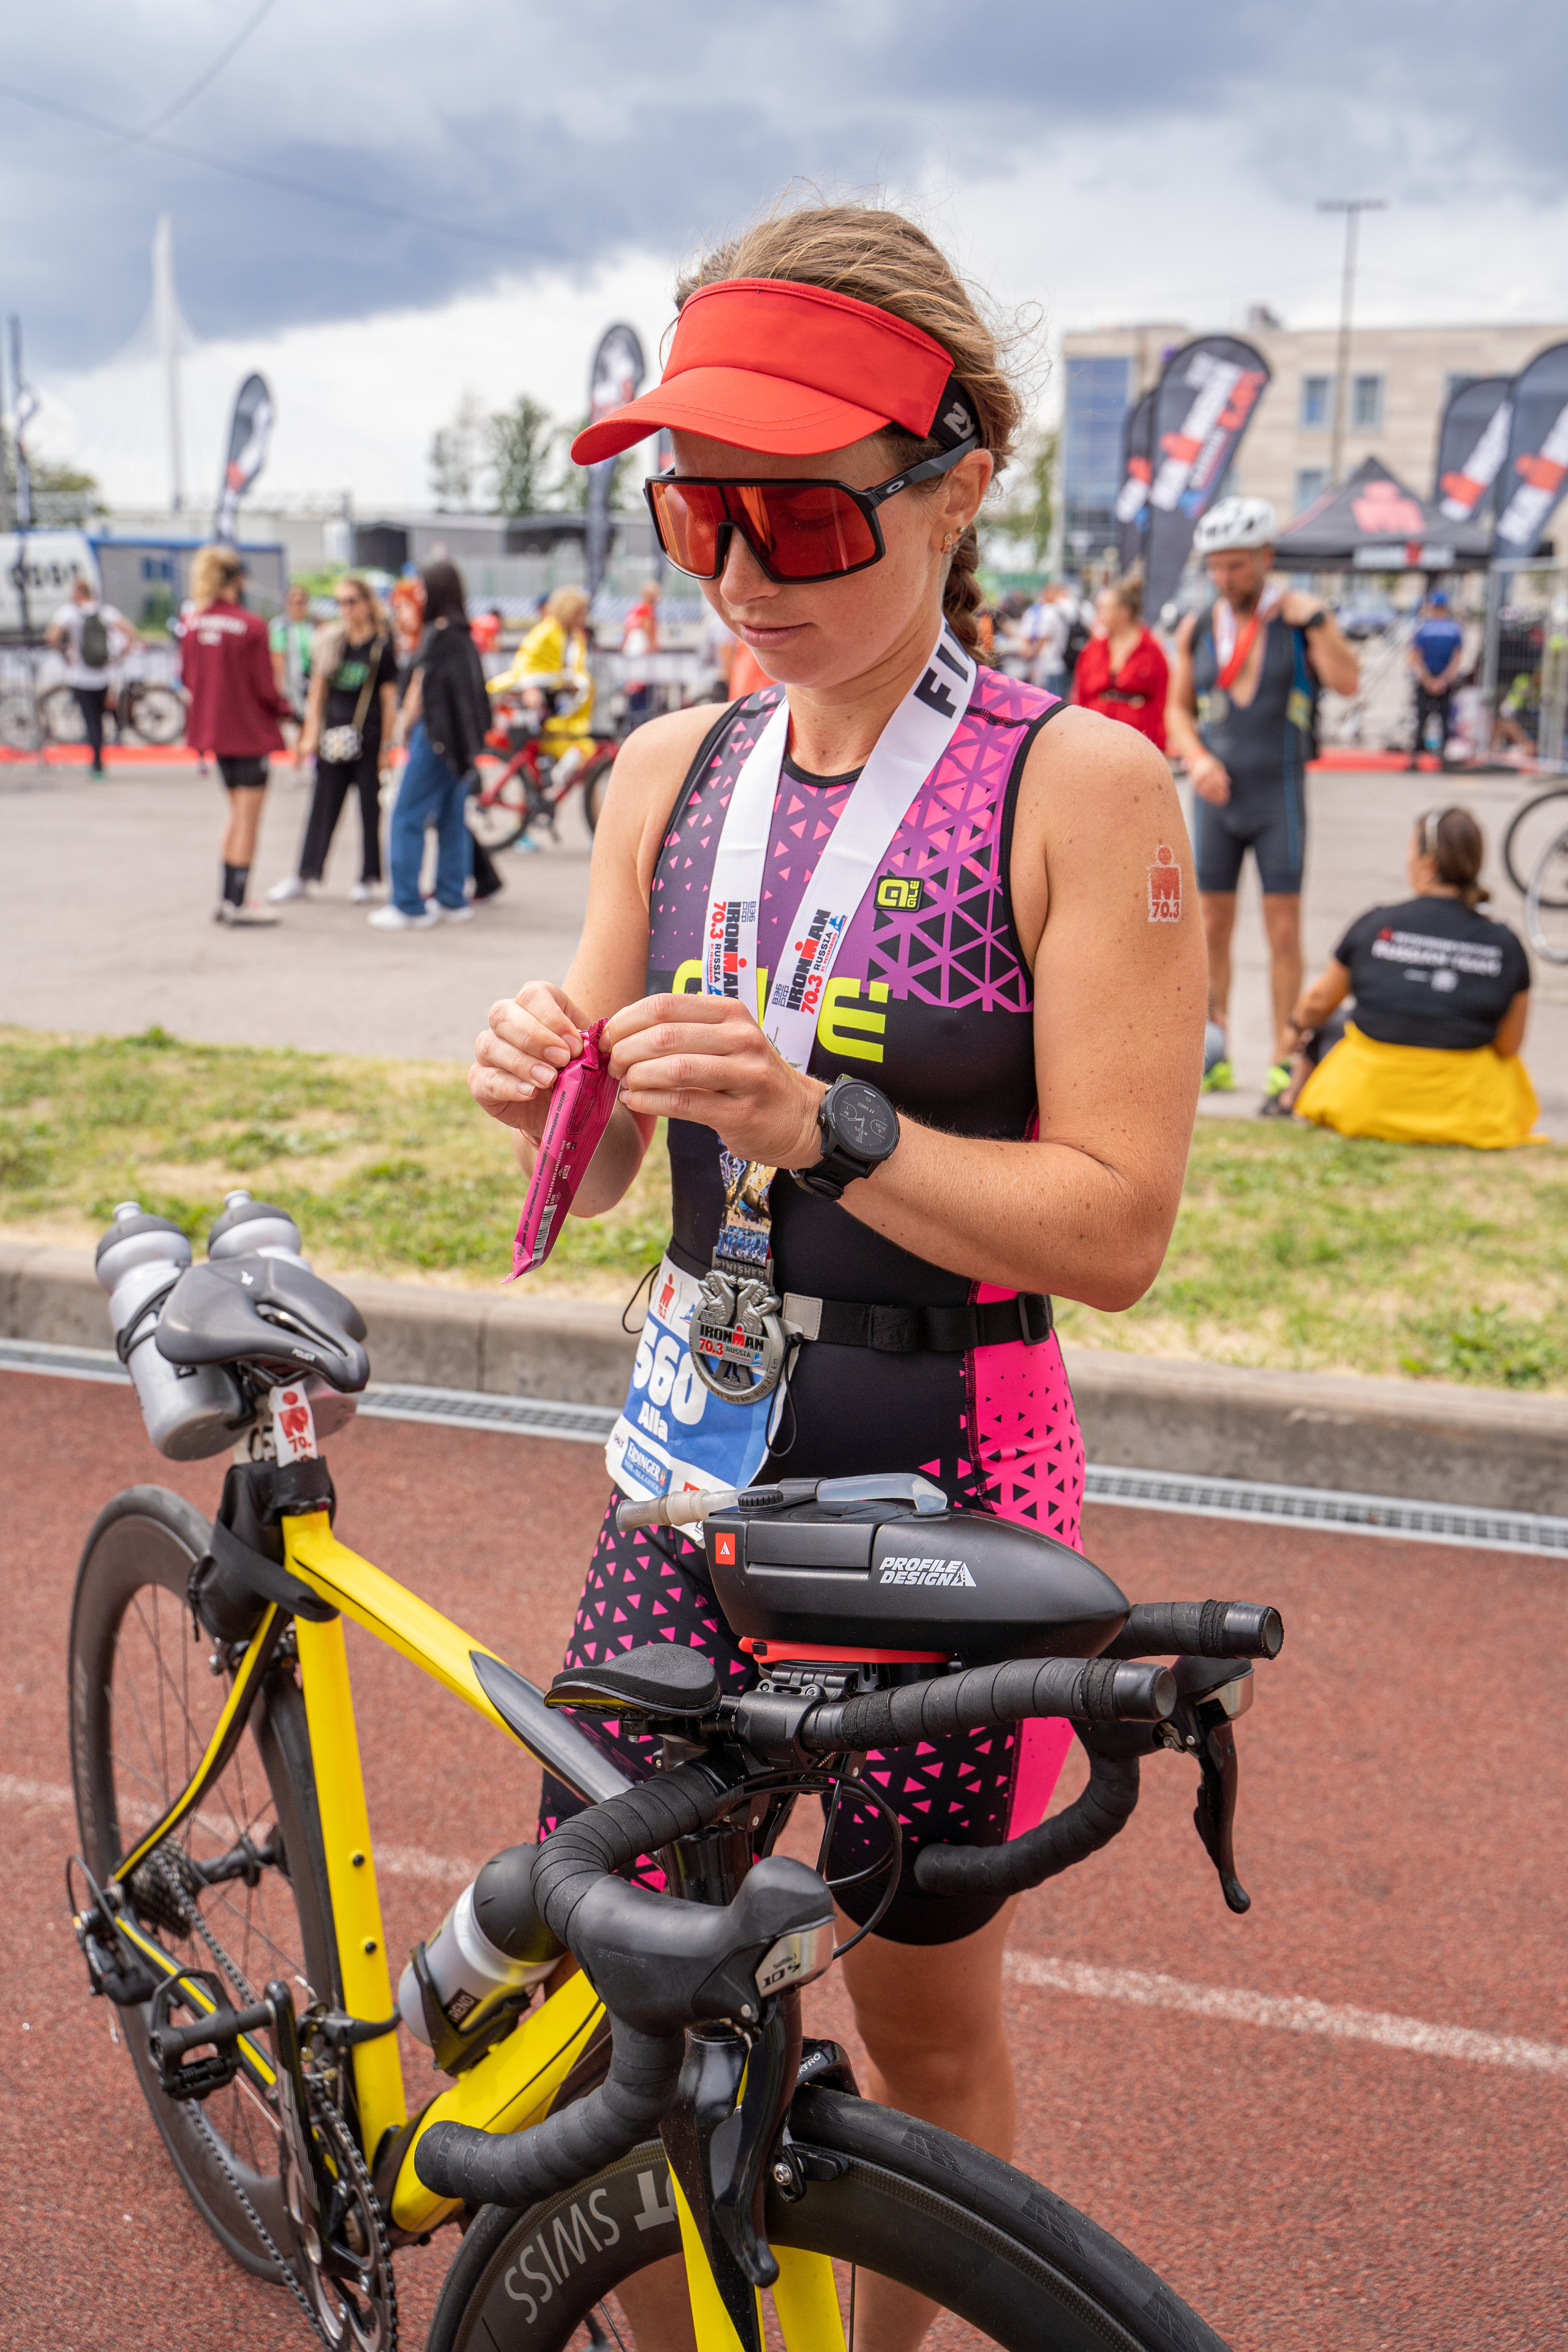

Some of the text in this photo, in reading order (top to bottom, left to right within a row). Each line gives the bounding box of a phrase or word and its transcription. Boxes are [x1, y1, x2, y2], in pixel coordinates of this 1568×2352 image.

[913, 622, 970, 719] FI
[710, 902, 727, 939] 70.3
[1152, 901, 1180, 919] 70.3
[786, 909, 831, 1011] IRONMAN
[801, 932, 833, 1015] 70.3 RUSSIA
[517, 1232, 527, 1256] Батончик
[548, 1113, 559, 1145] шоколадной
[557, 1090, 566, 1112] глазури
[717, 1259, 766, 1280] FINISHER
[698, 1338, 752, 1359] 70.3 RUSSIA
[699, 1323, 764, 1352] IRONMAN
[633, 1317, 708, 1425] 560
[754, 1385, 767, 1396] RUN
[771, 1359, 778, 1370] km
[710, 1386, 724, 1399] BIKE
[637, 1400, 668, 1443] Alla
[879, 1557, 963, 1574] PROFILE
[880, 1570, 954, 1586] DESIGN
[505, 2169, 679, 2324] T SWISS
